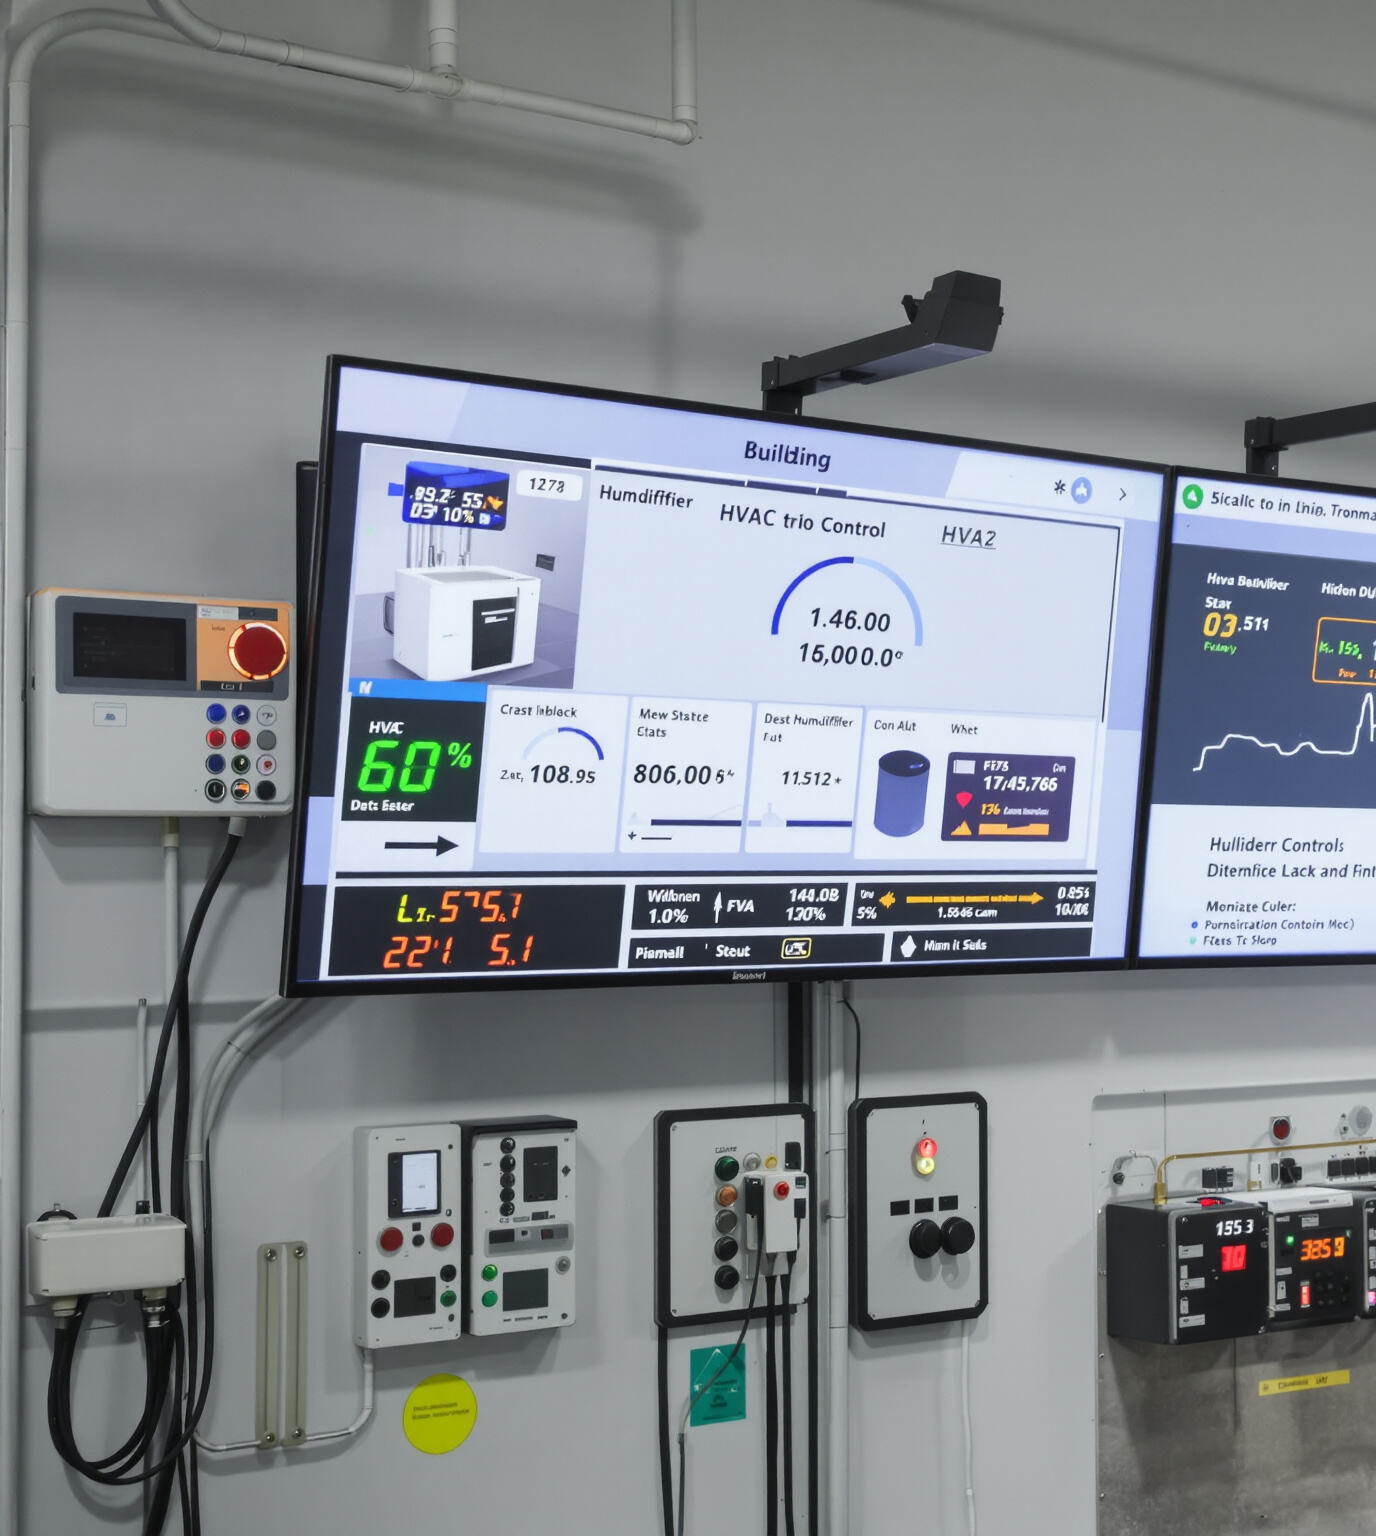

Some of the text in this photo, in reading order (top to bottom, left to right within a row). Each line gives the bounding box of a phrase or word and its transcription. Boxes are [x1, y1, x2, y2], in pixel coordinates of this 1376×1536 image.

[1260, 498, 1273, 510] to
[1278, 499, 1290, 513] in
[720, 503, 886, 538] HVAC trio Control
[941, 525, 997, 547] HVA2
[811, 607, 891, 632] 1.46.00
[764, 713, 791, 725] Dest
[530, 764, 596, 784] 108.95
[1282, 837, 1344, 853] Controls
[1281, 864, 1316, 878] Lack
[1320, 864, 1348, 878] and
[727, 899, 754, 913] FVA
